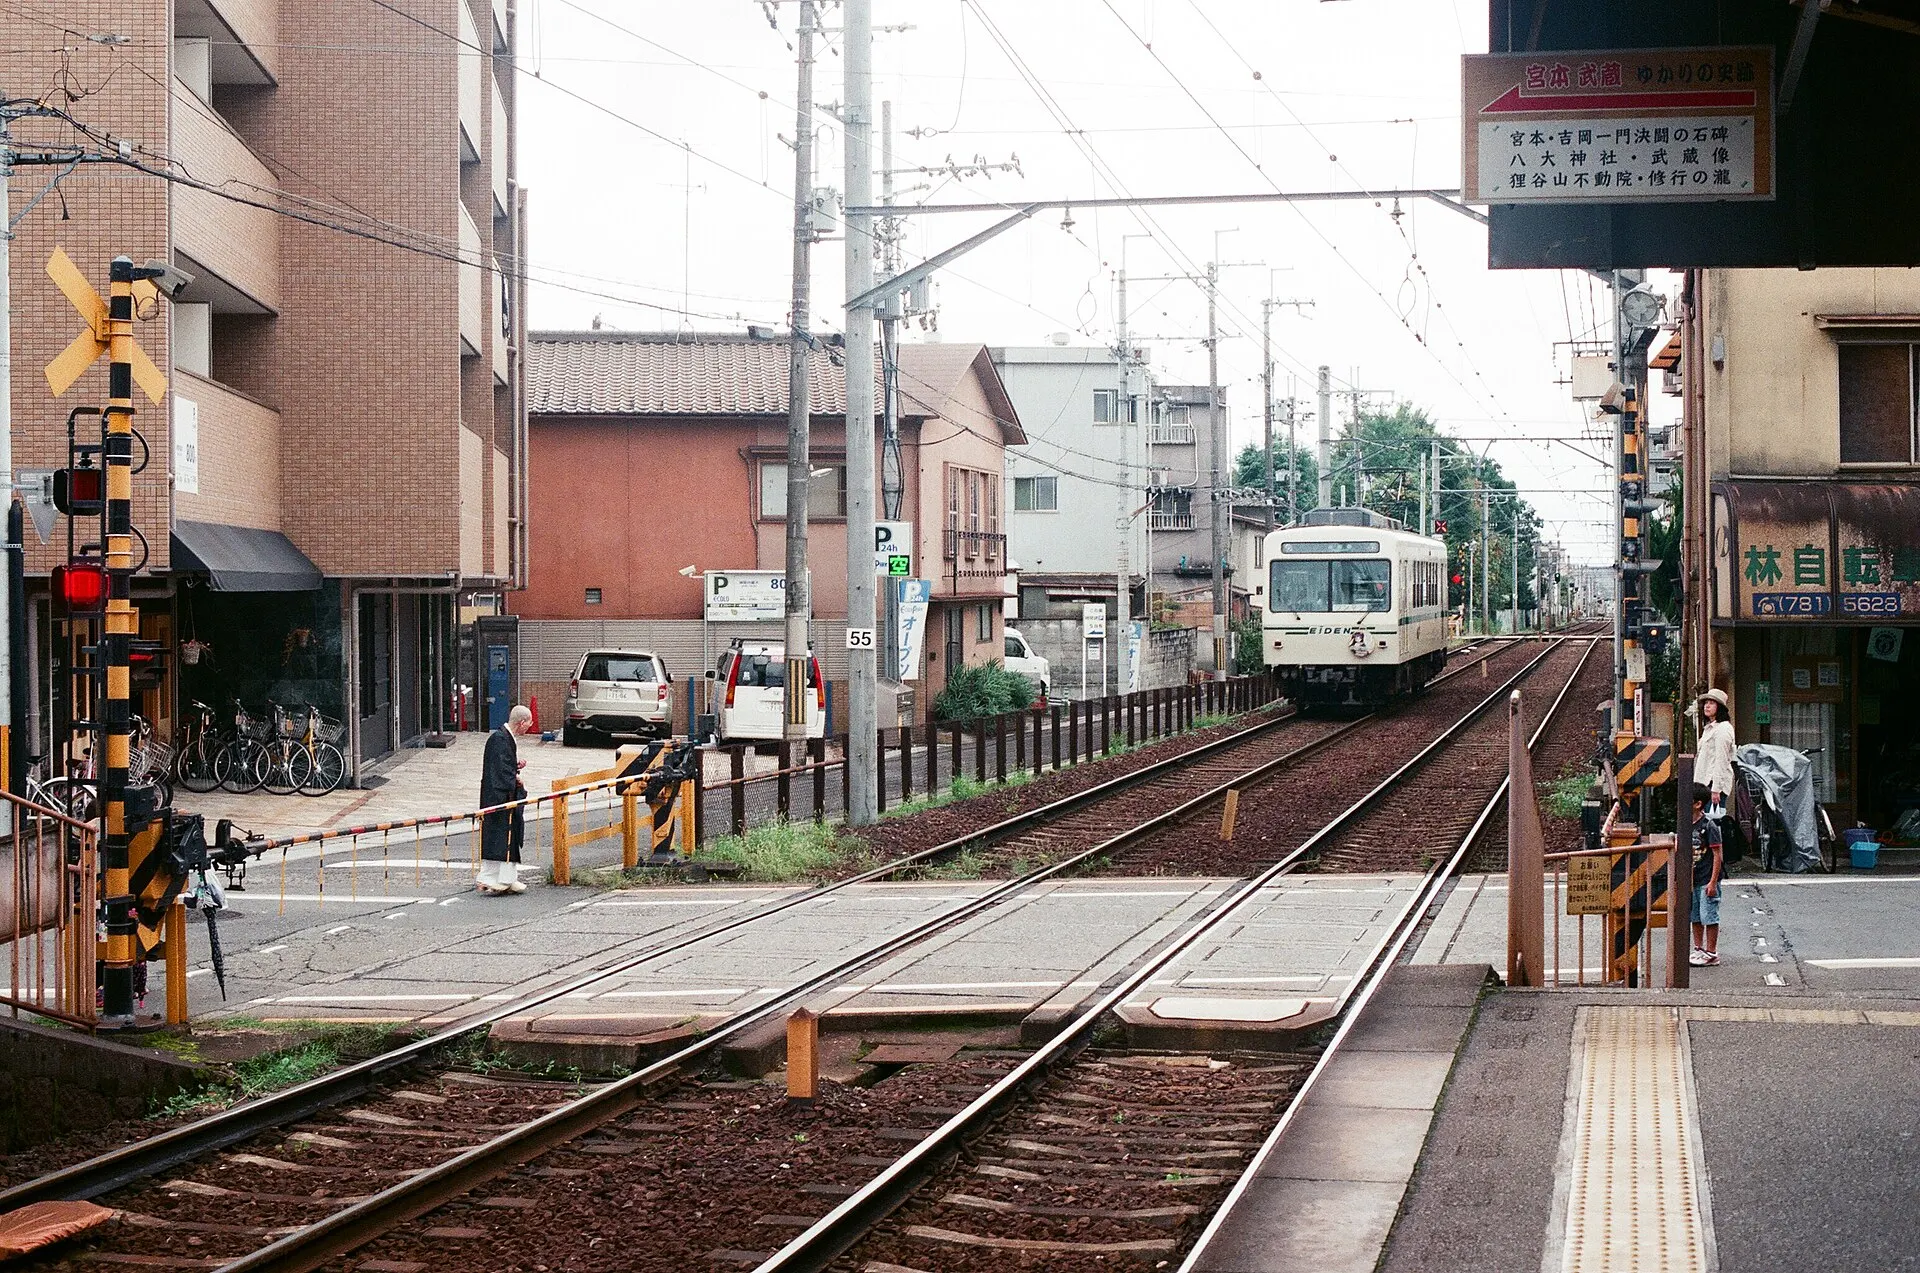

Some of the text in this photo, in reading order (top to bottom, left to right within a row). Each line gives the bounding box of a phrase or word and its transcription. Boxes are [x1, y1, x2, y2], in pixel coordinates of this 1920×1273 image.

[1525, 63, 1571, 90] 宮本
[1578, 61, 1622, 88] 武蔵
[1509, 126, 1730, 147] 宮本・吉岡一門決闘の石碑
[1509, 147, 1731, 168] 八大神社・武蔵像
[875, 526, 892, 552] P
[881, 544, 898, 552] 24h
[889, 555, 909, 576] 空
[714, 576, 729, 594] P
[904, 581, 923, 602] P
[1779, 596, 1832, 612] (781)
[850, 631, 872, 646] 55
[900, 616, 917, 677] オープン
